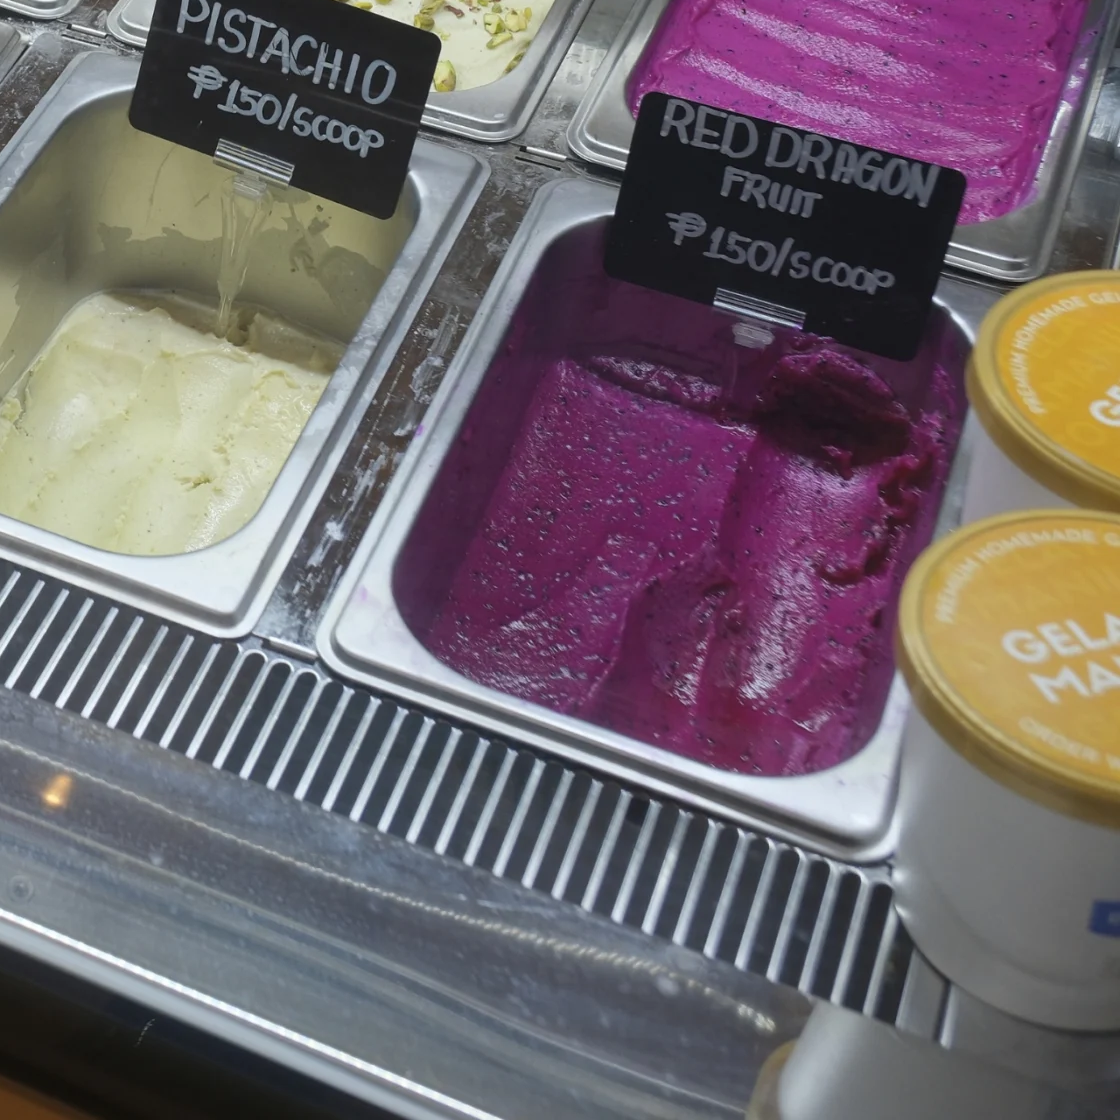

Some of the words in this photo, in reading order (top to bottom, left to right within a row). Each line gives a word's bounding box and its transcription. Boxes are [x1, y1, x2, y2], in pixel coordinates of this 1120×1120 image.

[659, 99, 759, 159] RED
[764, 126, 941, 208] DRAGON
[720, 165, 823, 218] FRUIT
[974, 528, 1099, 563] HOMEMADE
